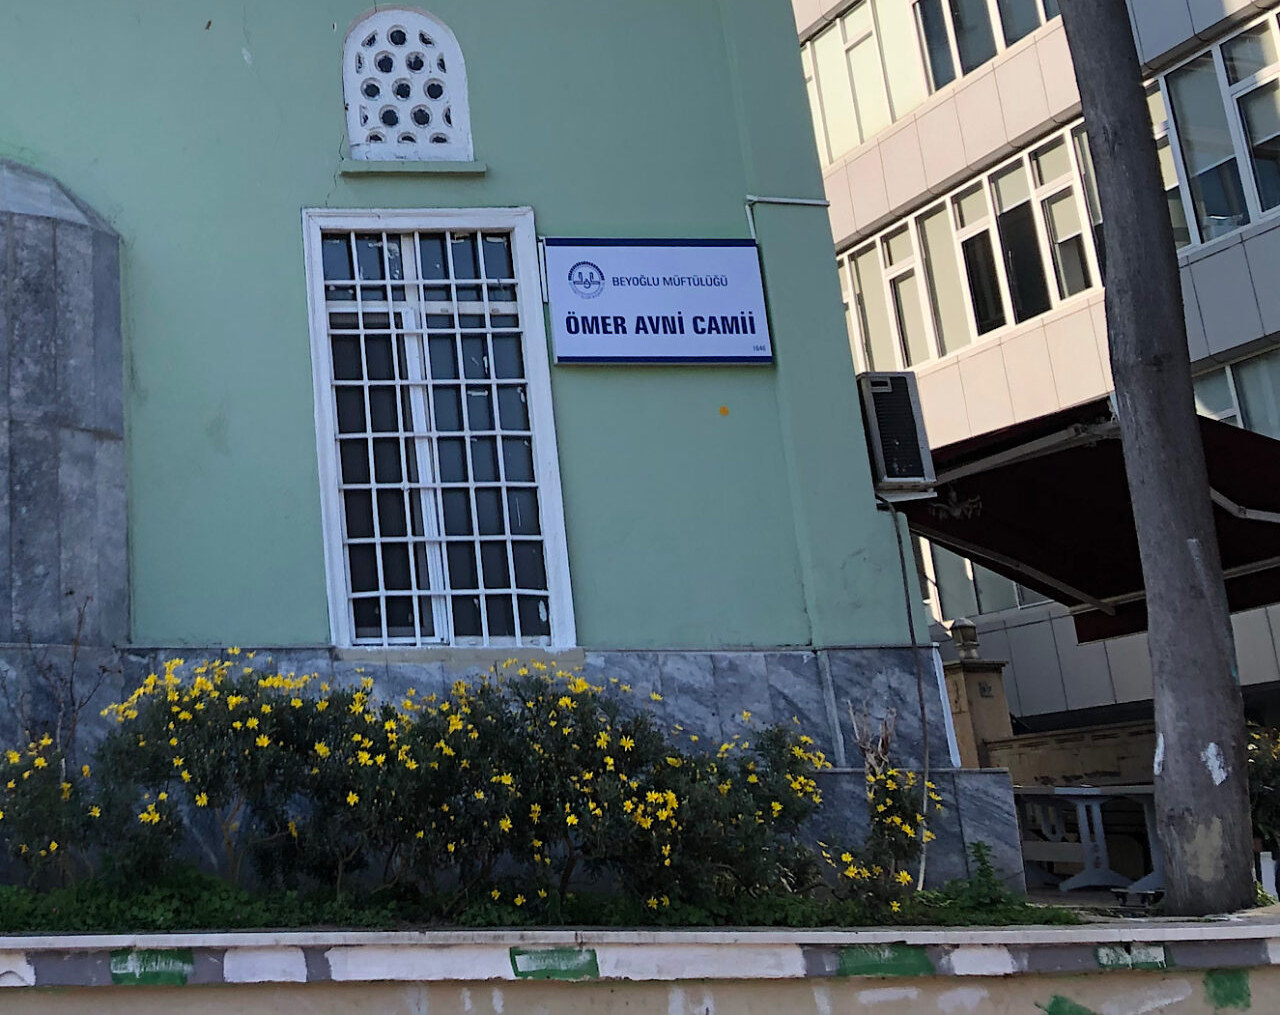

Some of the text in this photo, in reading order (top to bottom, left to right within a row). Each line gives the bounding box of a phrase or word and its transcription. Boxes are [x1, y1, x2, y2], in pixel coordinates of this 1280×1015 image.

[612, 274, 728, 287] BEYOĞLU MÜFTÜLÜĞÜ
[565, 311, 756, 335] ÖMER AVNİ CAMİİ
